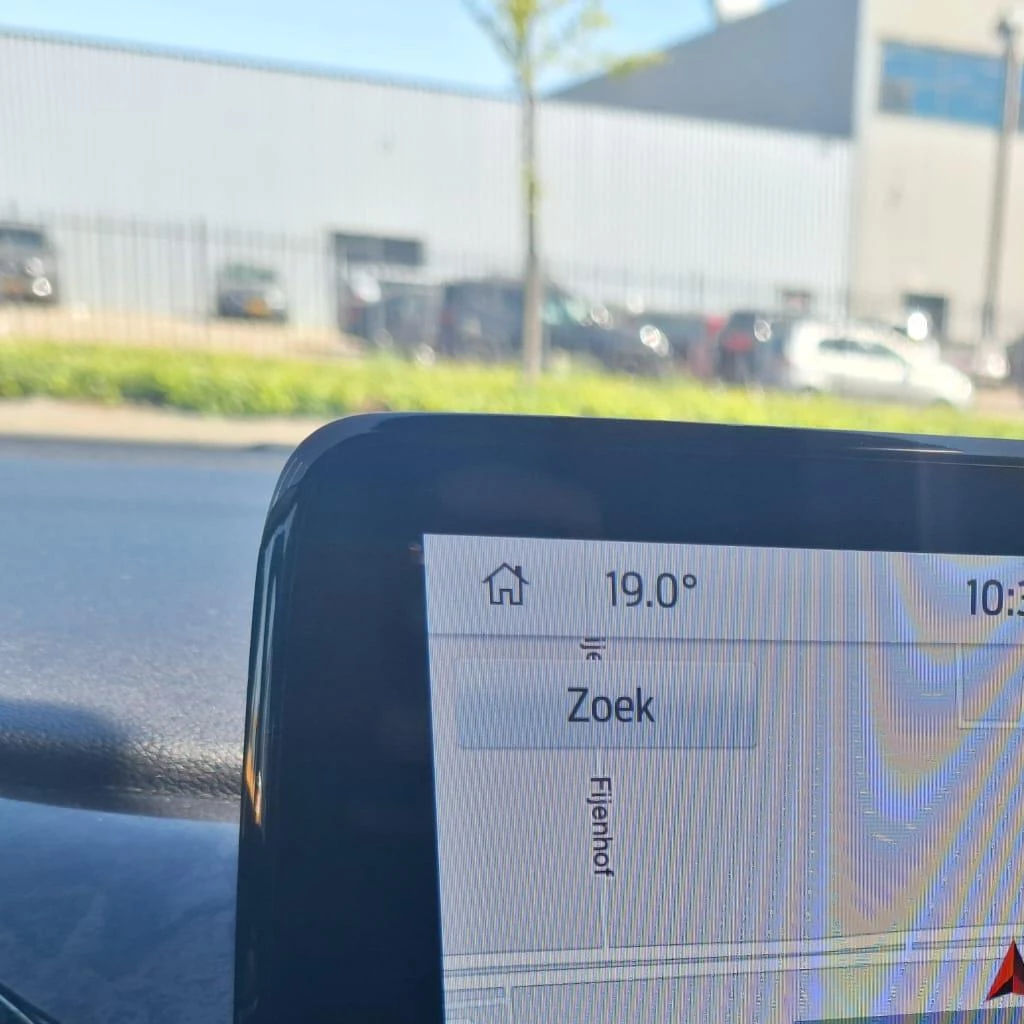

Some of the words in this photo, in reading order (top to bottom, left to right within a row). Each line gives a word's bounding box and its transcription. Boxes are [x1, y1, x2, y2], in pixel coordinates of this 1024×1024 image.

[605, 571, 698, 608] 19.0°
[567, 687, 655, 723] Zoek
[587, 776, 615, 878] Fijenhof
